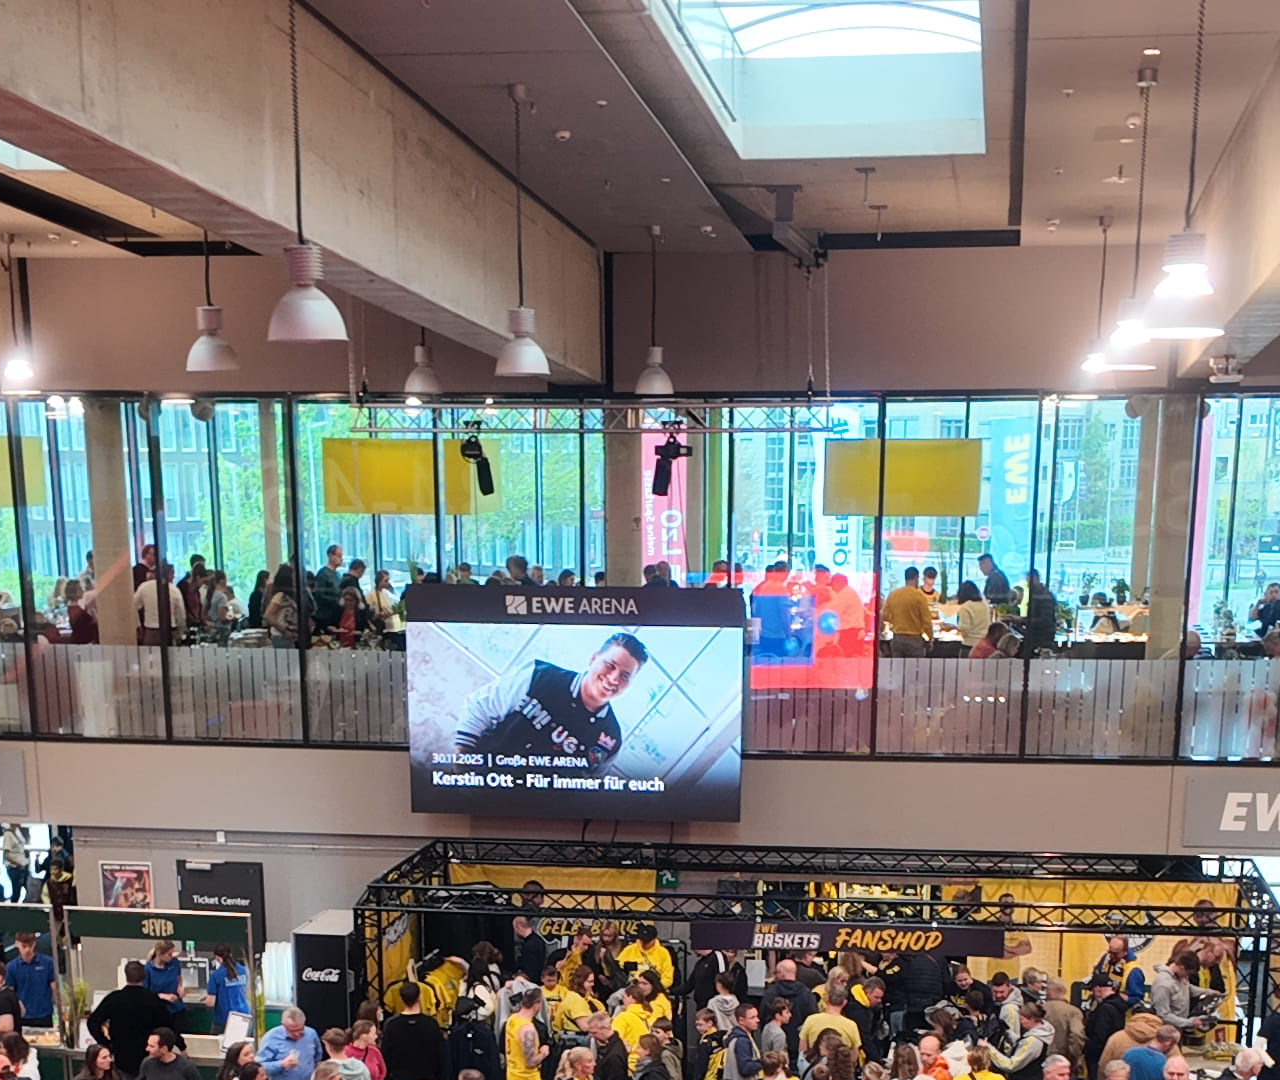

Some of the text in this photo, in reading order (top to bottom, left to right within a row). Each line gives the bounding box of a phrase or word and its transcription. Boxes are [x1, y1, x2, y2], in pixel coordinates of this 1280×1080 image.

[532, 597, 638, 615] EWE ARENA
[432, 753, 483, 766] 30.11.2025
[495, 755, 528, 769] Große
[528, 756, 552, 767] EWE
[552, 757, 588, 768] ARENA
[432, 771, 485, 787] Kerstin
[487, 773, 514, 788] Ott
[526, 773, 551, 789] Für
[553, 774, 601, 790] immer
[604, 775, 626, 791] für
[628, 777, 664, 792] euch
[192, 894, 251, 907] Ticket Center
[141, 918, 174, 937] JEVER
[752, 932, 820, 949] BASKETS
[835, 928, 943, 952] FANSHOP
[302, 967, 340, 983] Coca-Cola
